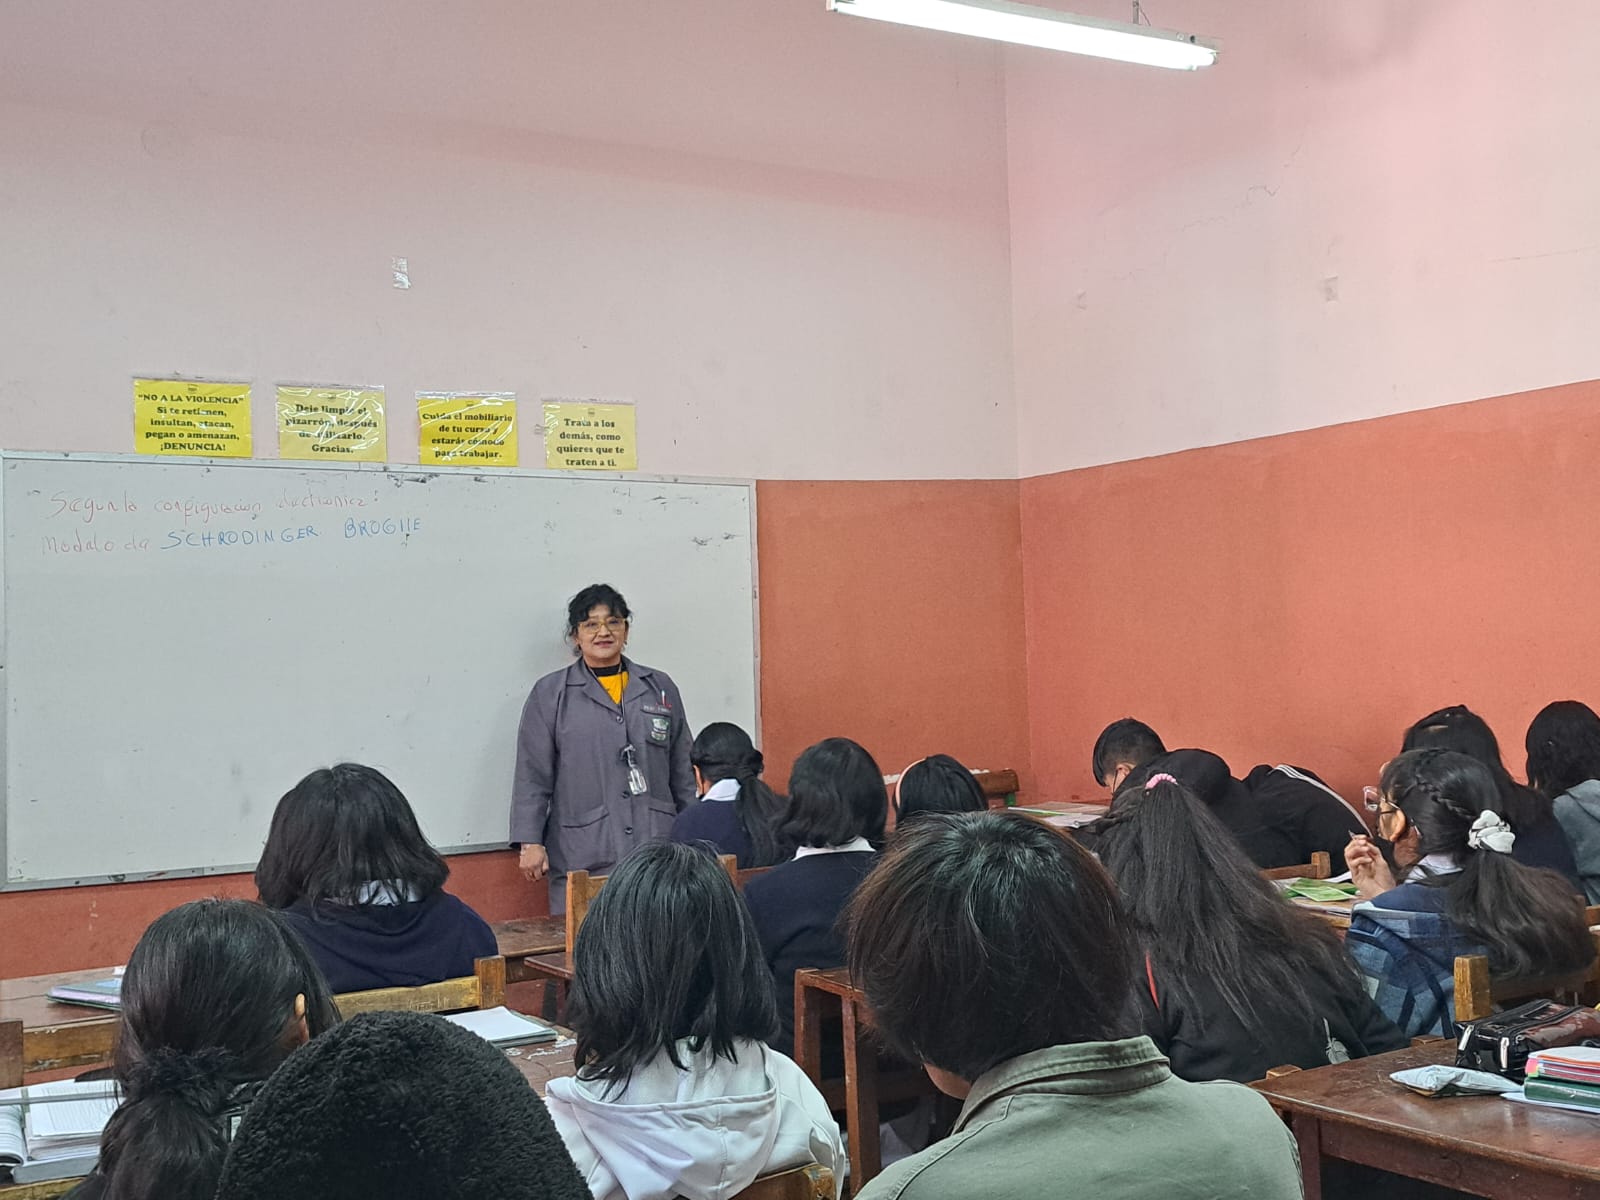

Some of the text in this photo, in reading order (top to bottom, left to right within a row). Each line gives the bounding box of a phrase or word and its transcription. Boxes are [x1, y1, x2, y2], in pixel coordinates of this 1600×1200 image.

[156, 406, 168, 414] Si
[422, 412, 513, 422] Cuida el mobiliario
[150, 418, 196, 428] insultan,
[438, 424, 450, 432] de
[602, 420, 615, 428] los
[145, 430, 176, 440] pegan
[187, 432, 240, 440] amenazan,
[560, 431, 594, 442] demás,
[160, 442, 226, 452] ¡DENUNCIA!
[312, 444, 354, 454] Gracias.
[556, 444, 594, 454] quieres
[596, 446, 614, 455] que
[460, 450, 502, 459] trabajar.
[566, 458, 598, 466] traten
[607, 458, 617, 467] ti.
[160, 525, 320, 550] SCHRODINGER
